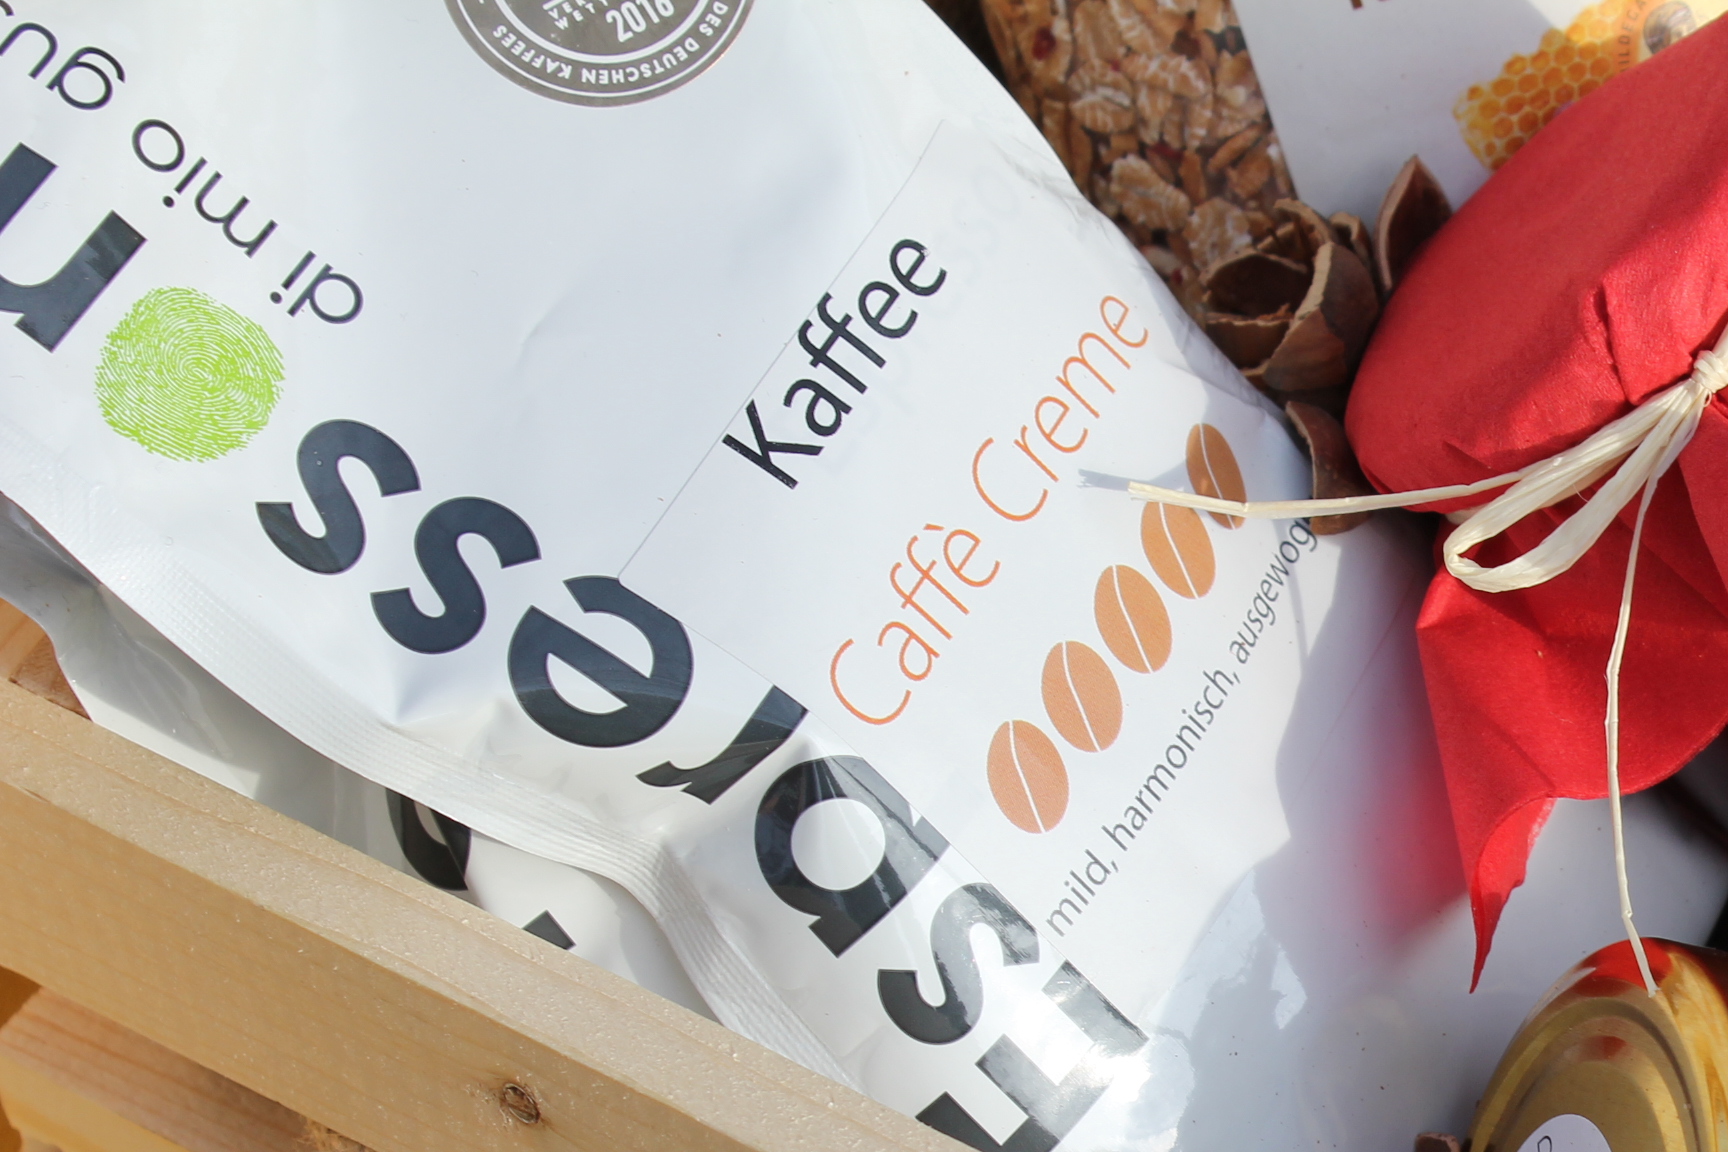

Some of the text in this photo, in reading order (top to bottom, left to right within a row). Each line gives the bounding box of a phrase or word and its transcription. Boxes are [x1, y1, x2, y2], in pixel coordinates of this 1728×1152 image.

[0, 0, 363, 324] di mio gu
[492, 0, 729, 84] DES DEUTSCHEN KAFFEES
[721, 238, 947, 489] Kaffee
[829, 523, 1000, 725] Caffè
[971, 295, 1149, 522] Creme
[1045, 517, 1318, 938] mild, harmonisch, ausgewog
